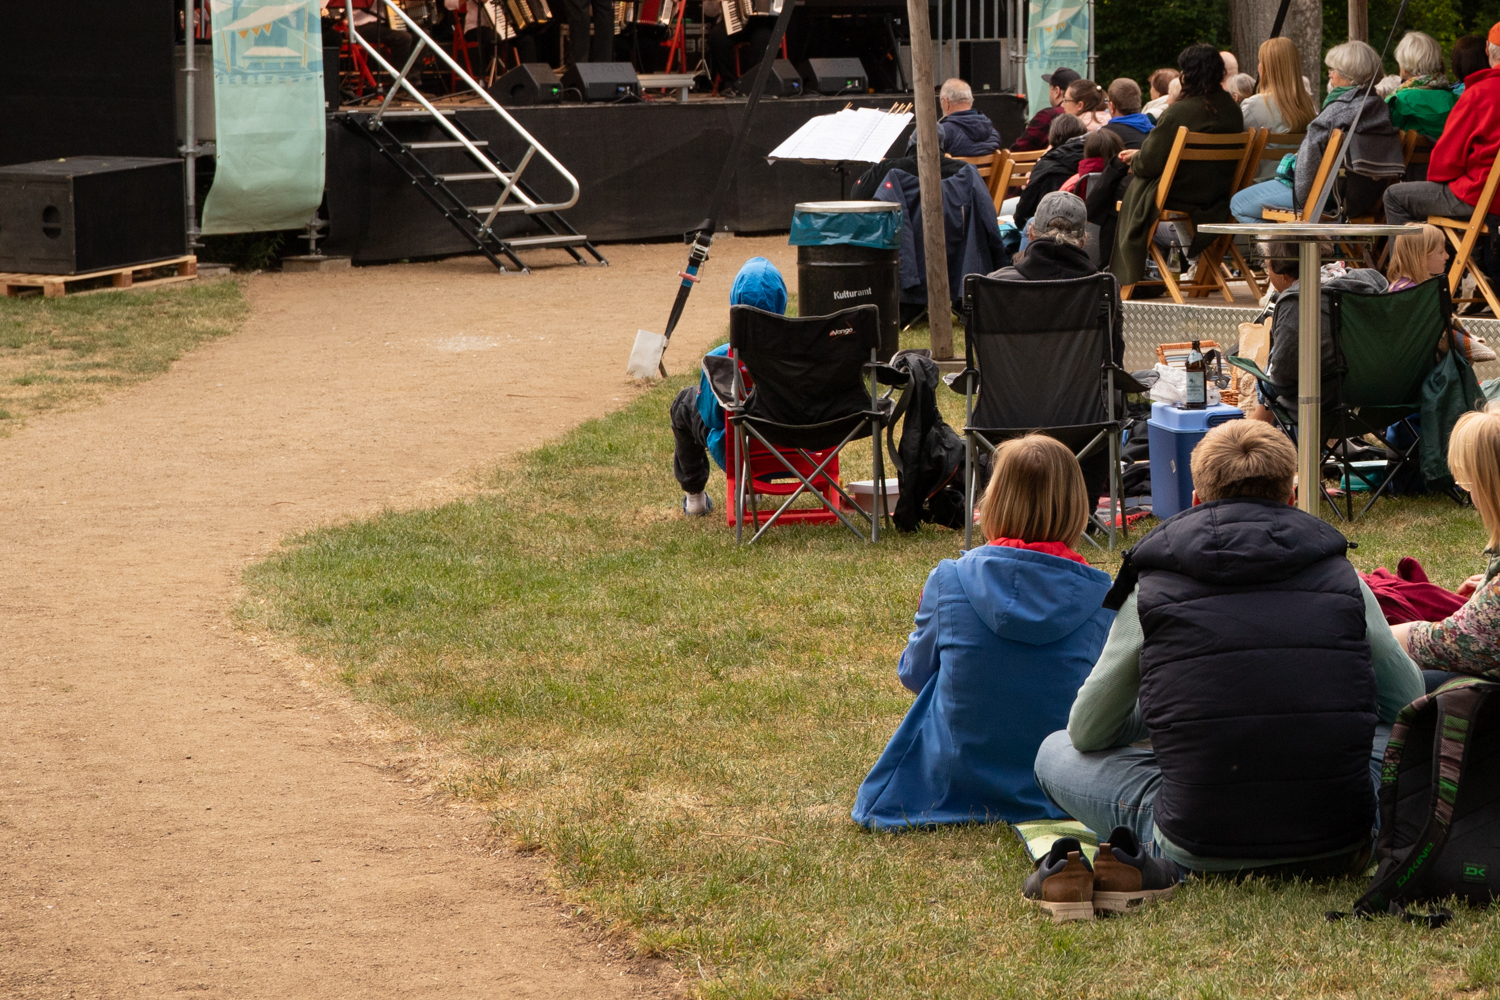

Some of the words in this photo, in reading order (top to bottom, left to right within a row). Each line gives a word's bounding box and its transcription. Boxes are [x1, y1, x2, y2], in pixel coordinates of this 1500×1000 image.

[833, 287, 872, 300] Kulturamt
[832, 327, 853, 336] Vango
[1396, 842, 1435, 888] DAKINE
